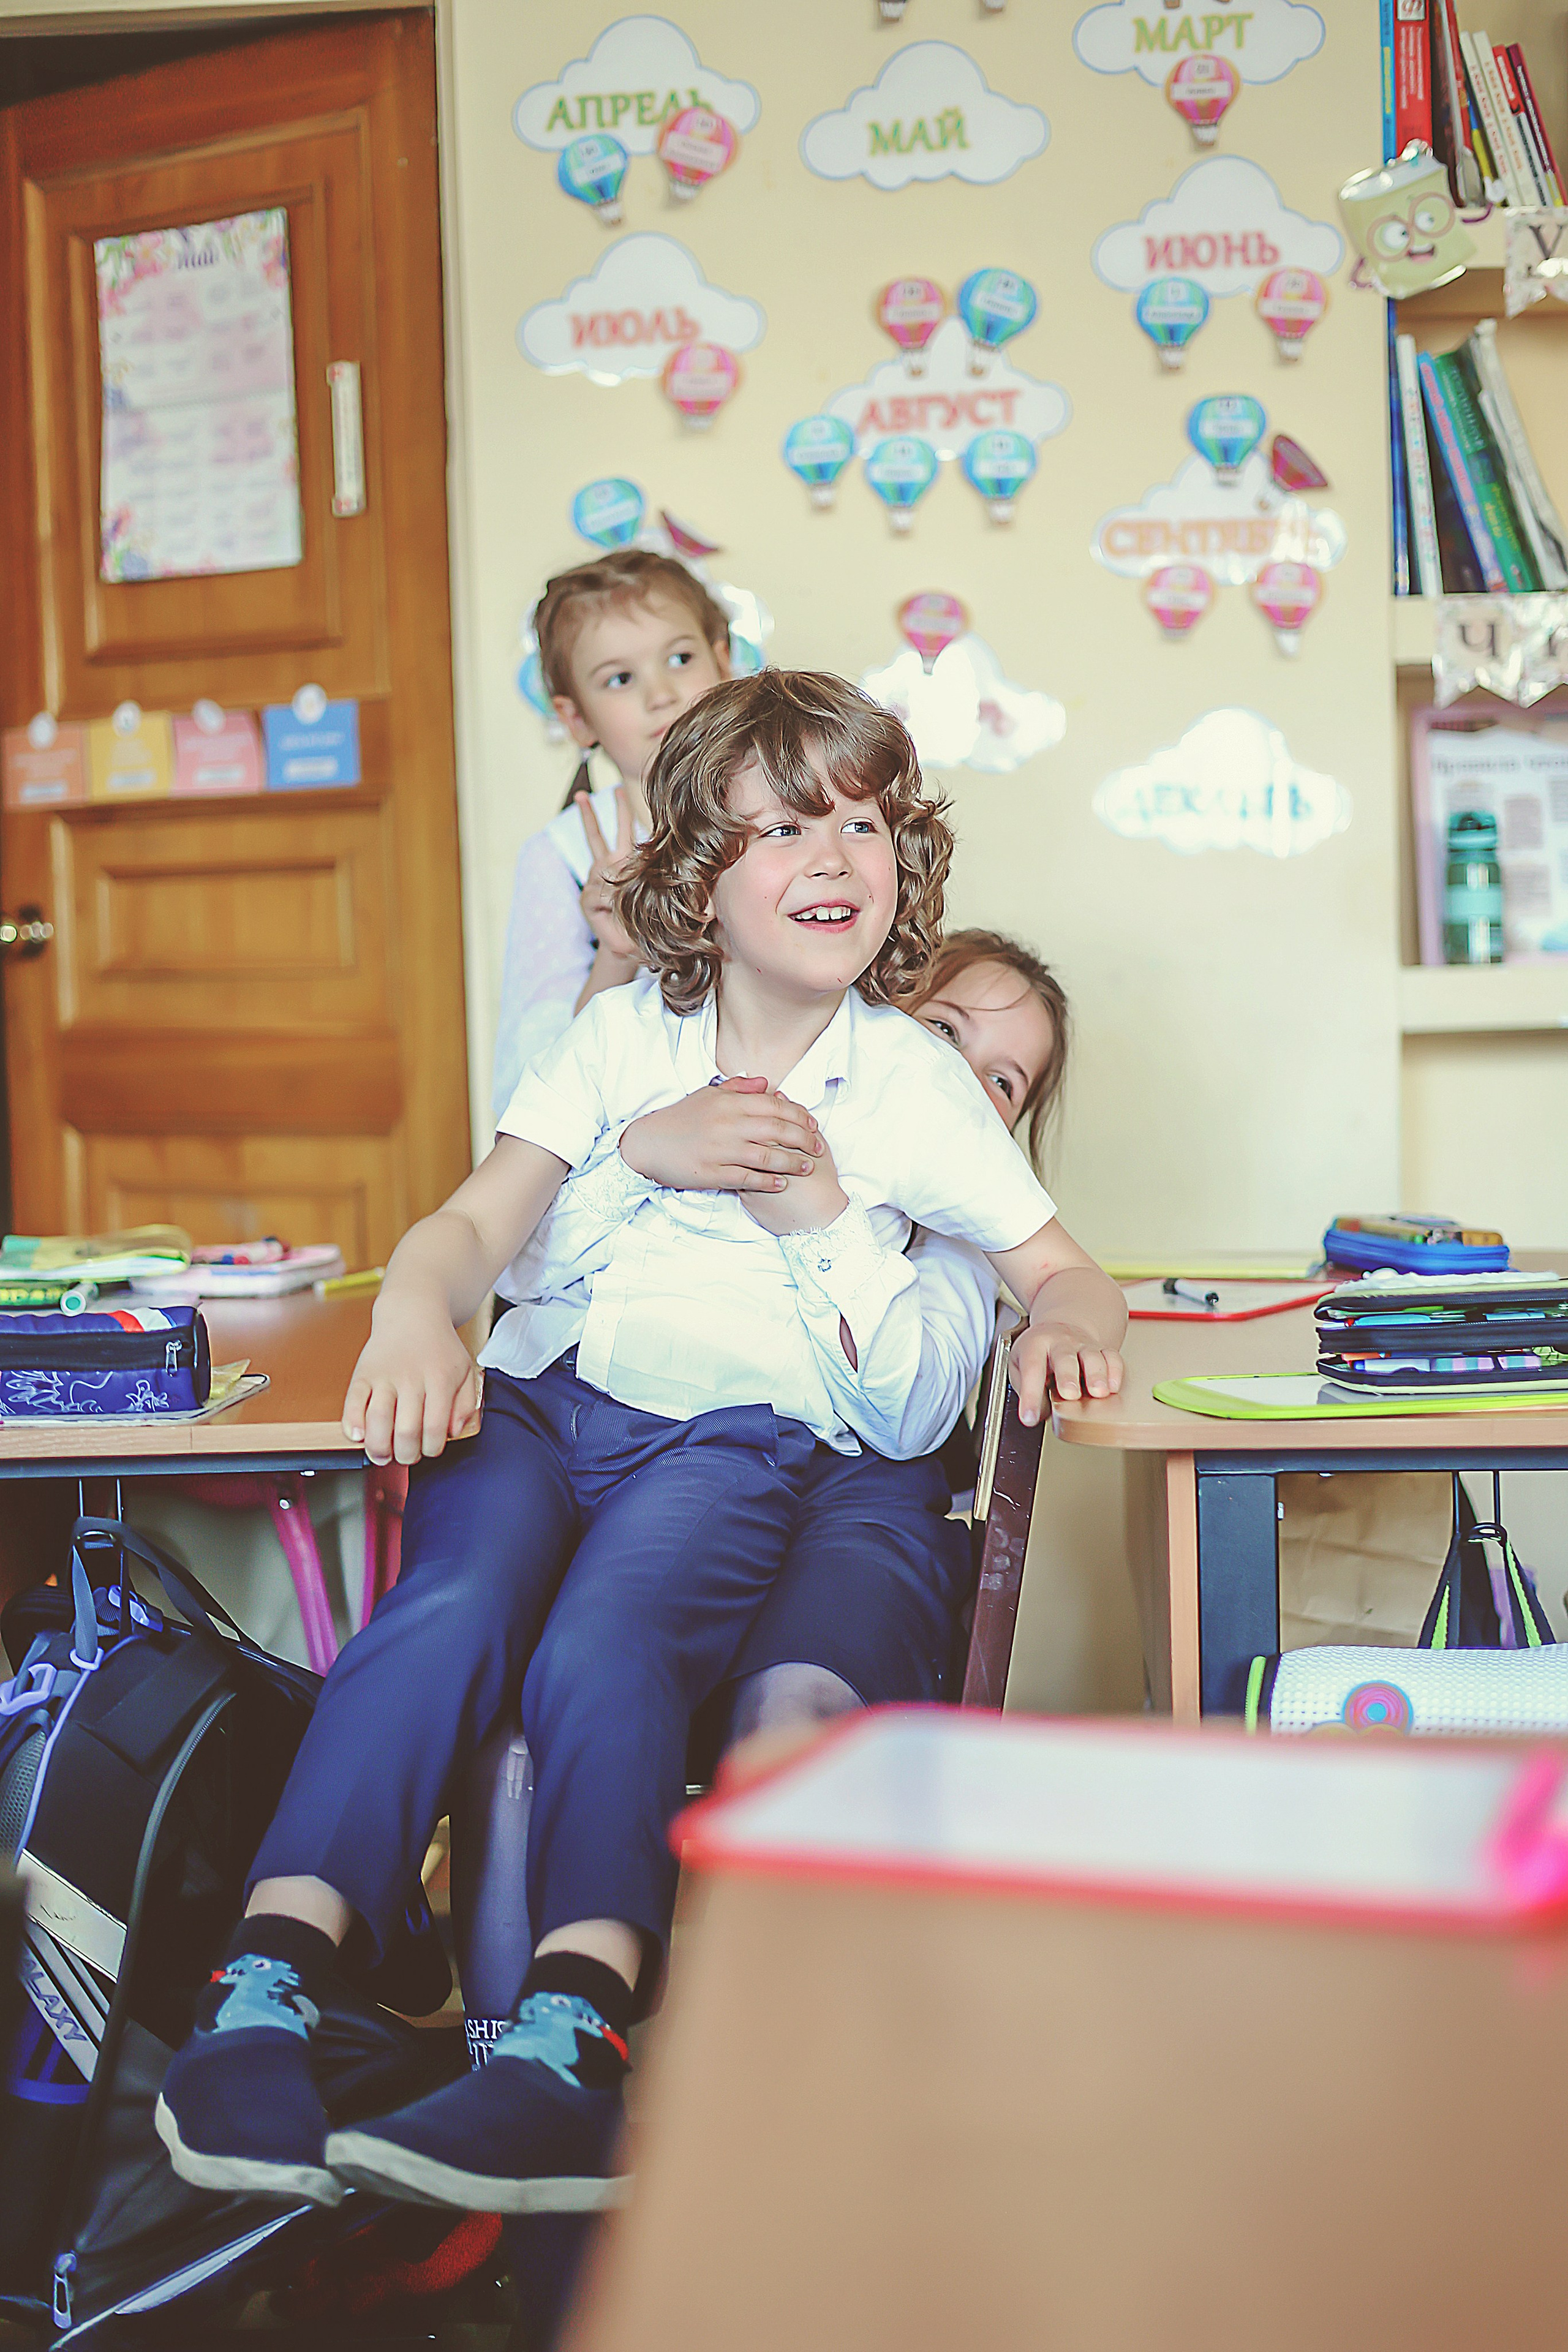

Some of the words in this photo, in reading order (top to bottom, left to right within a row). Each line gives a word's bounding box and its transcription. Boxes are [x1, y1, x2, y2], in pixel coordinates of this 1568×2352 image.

[1133, 12, 1254, 53] МАРТ
[867, 107, 969, 157] МАЙ
[1145, 231, 1280, 273] ИЮНЬ
[568, 307, 703, 350] ИЮЛЬ
[856, 388, 1022, 434] АВГУСТ
